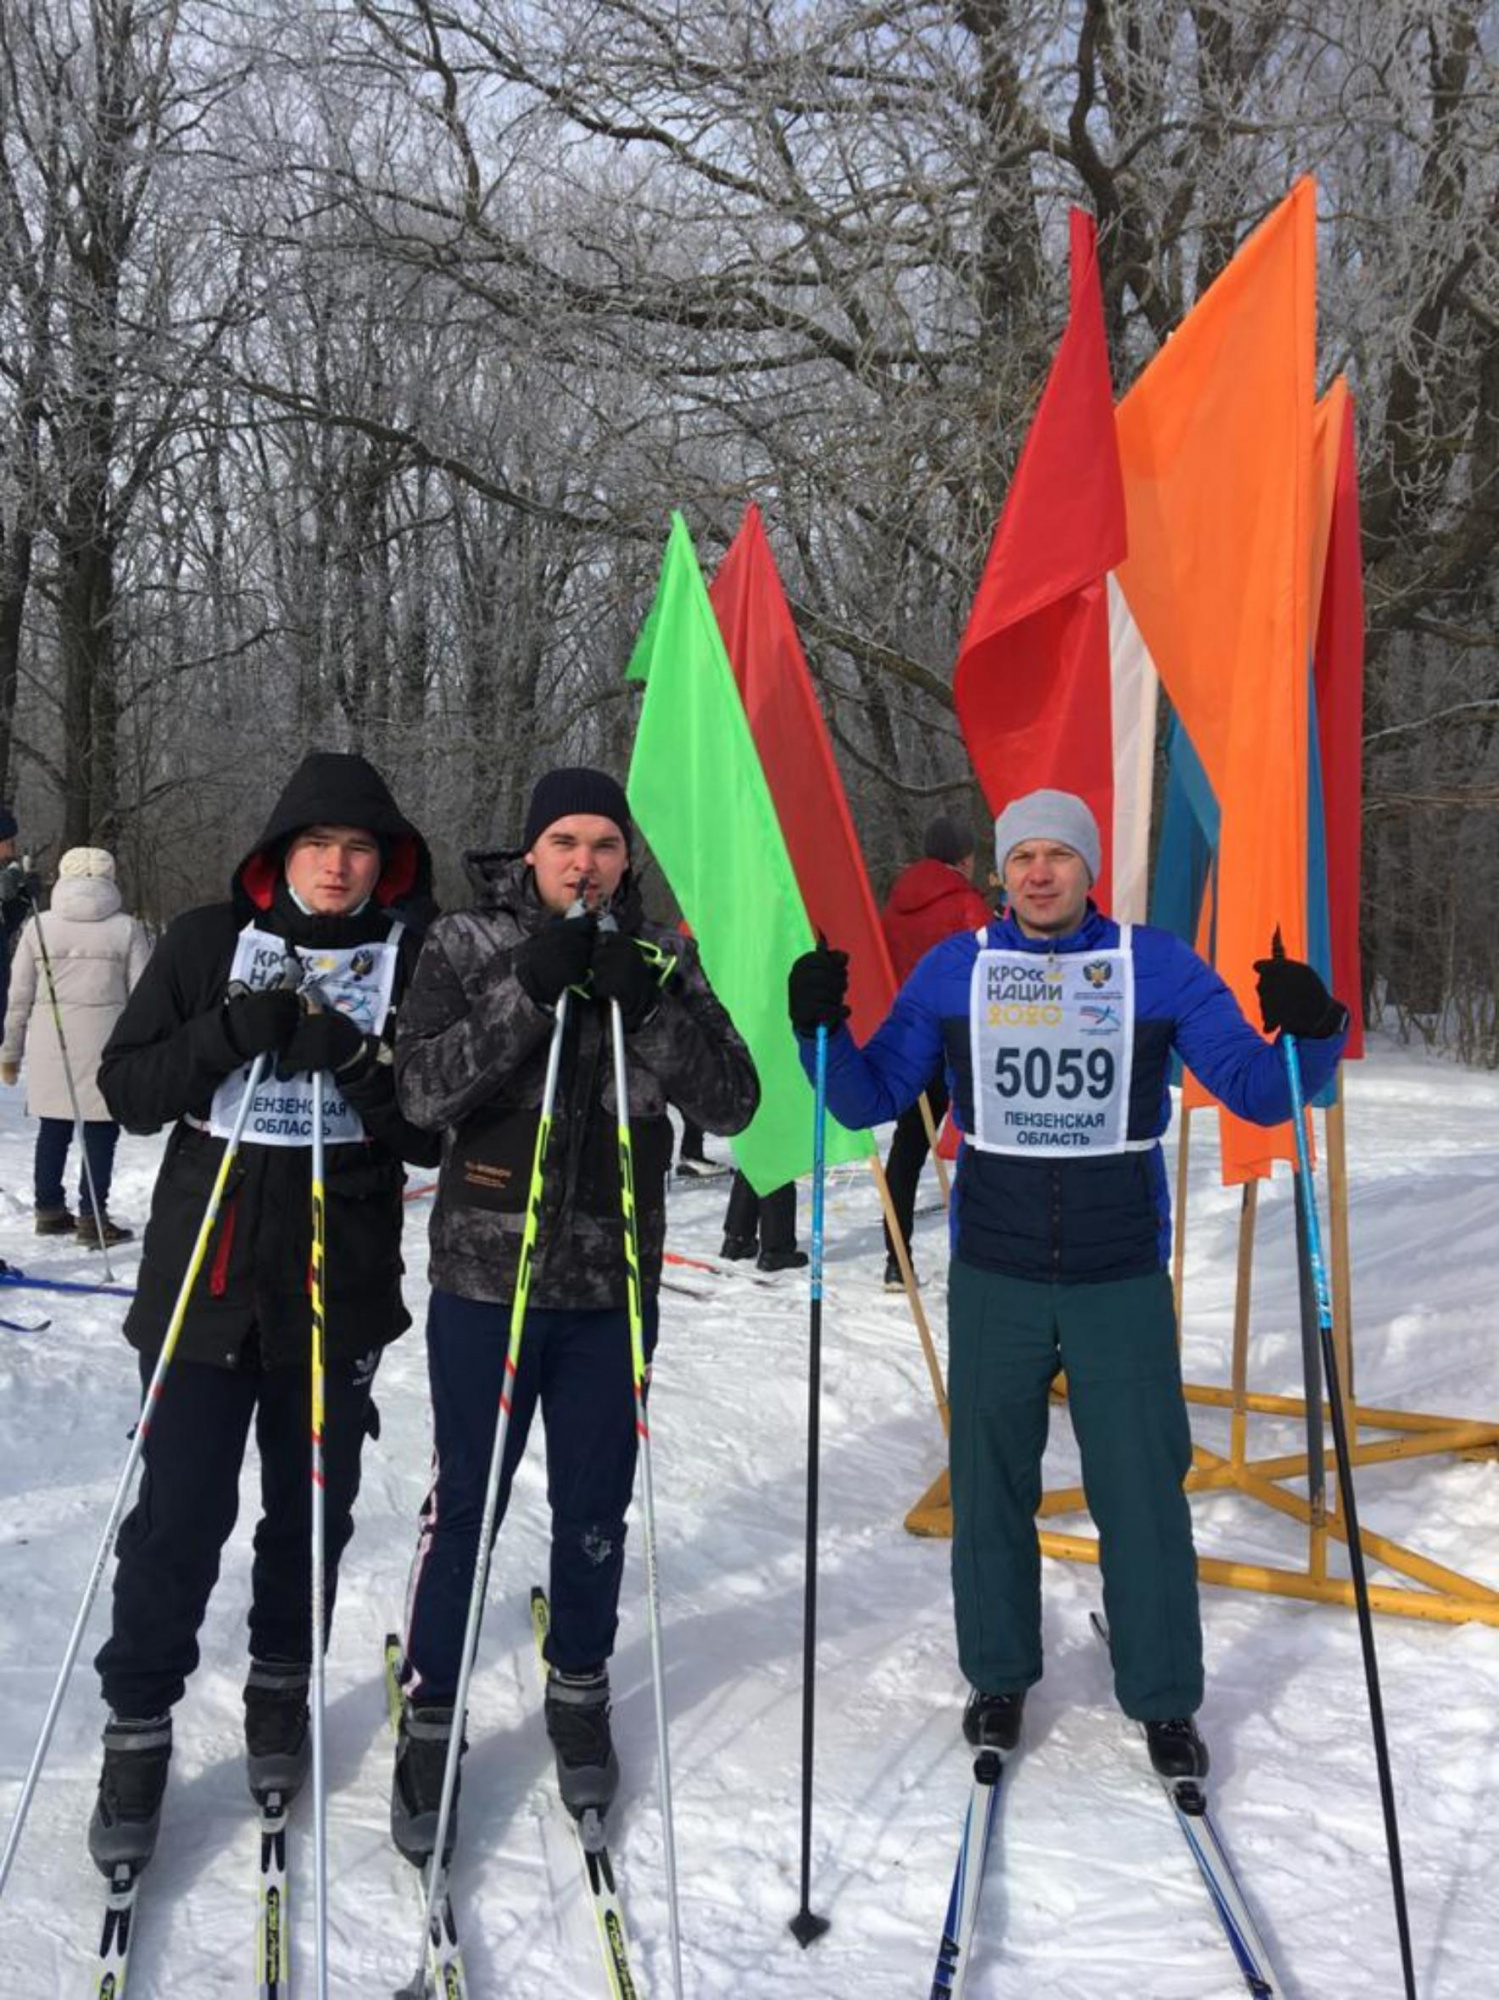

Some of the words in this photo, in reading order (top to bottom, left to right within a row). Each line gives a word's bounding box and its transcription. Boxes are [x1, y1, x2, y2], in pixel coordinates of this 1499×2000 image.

[987, 965, 1045, 983] КРОСС
[987, 983, 1063, 1002] НАЦИИ
[986, 1004, 1063, 1028] 2020
[995, 1046, 1115, 1099] 5059
[253, 1117, 331, 1137] ОБЛАСЬ
[1004, 1110, 1105, 1128] ПЕНЗЕНСКАЯ
[1016, 1130, 1090, 1147] ОБЛАСТЬ
